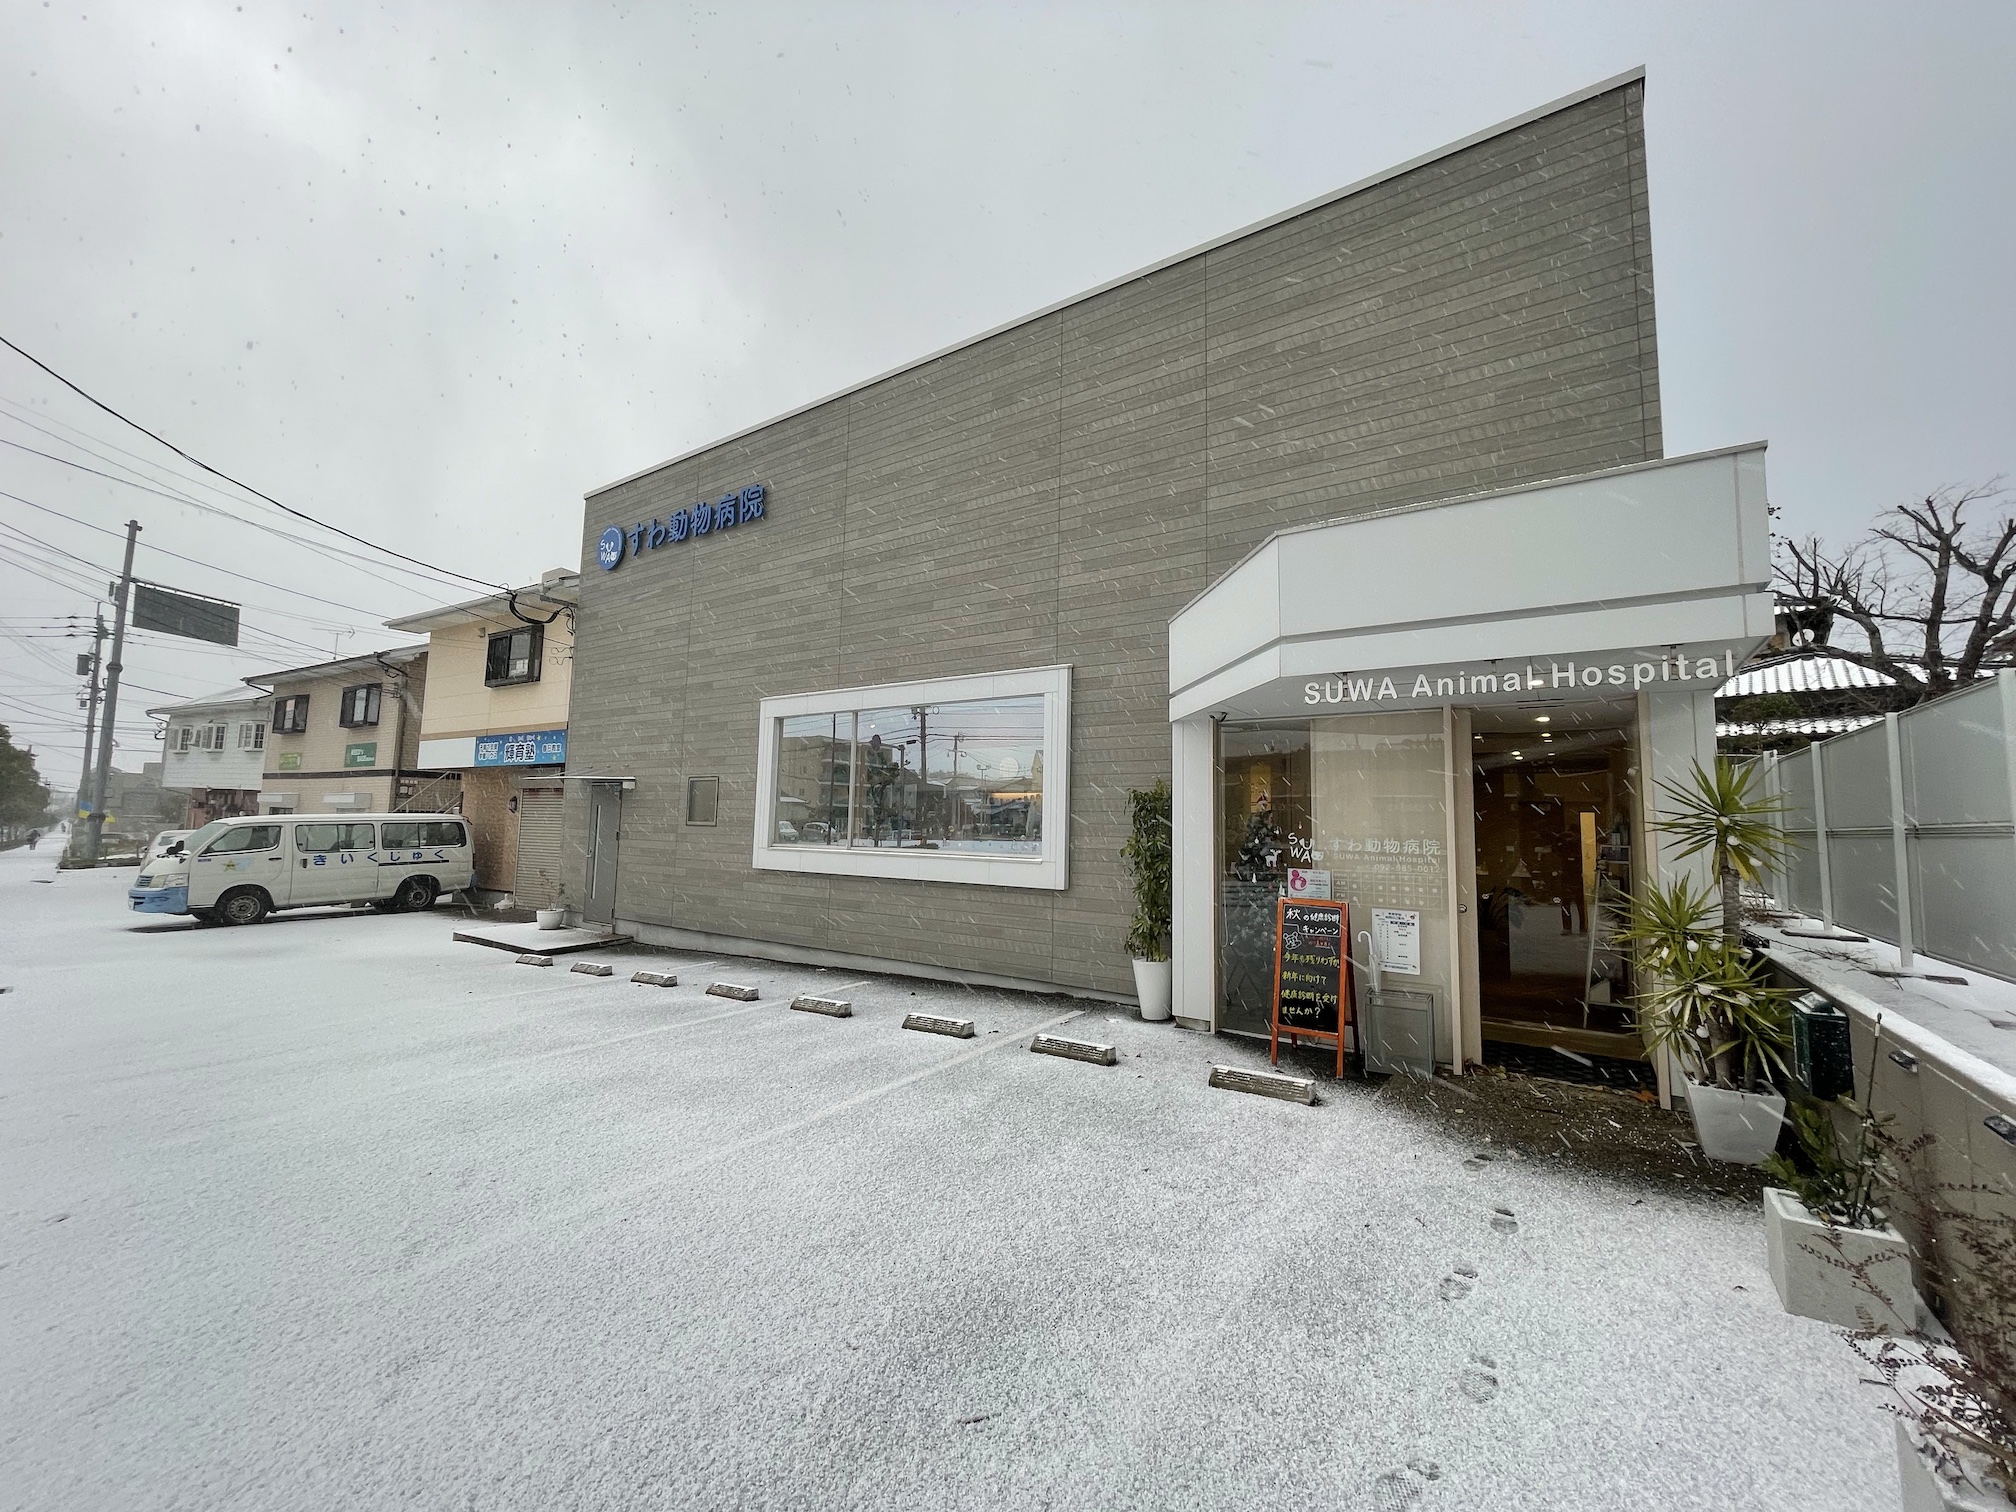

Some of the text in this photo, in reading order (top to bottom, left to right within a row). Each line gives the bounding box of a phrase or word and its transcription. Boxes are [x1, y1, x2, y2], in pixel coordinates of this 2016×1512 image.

[627, 484, 765, 555] すわ動物病院
[1303, 648, 1736, 706] SUWA Animal Hospital
[1329, 837, 1441, 855] すわ動物病院
[1364, 854, 1396, 862] Animal
[1399, 856, 1440, 865] Hospital
[1302, 925, 1338, 935] キャンペーン
[1282, 971, 1327, 985] 新年に向けて
[1281, 989, 1338, 1005] 健康診断を受け
[1282, 1006, 1321, 1018] ませんか?
